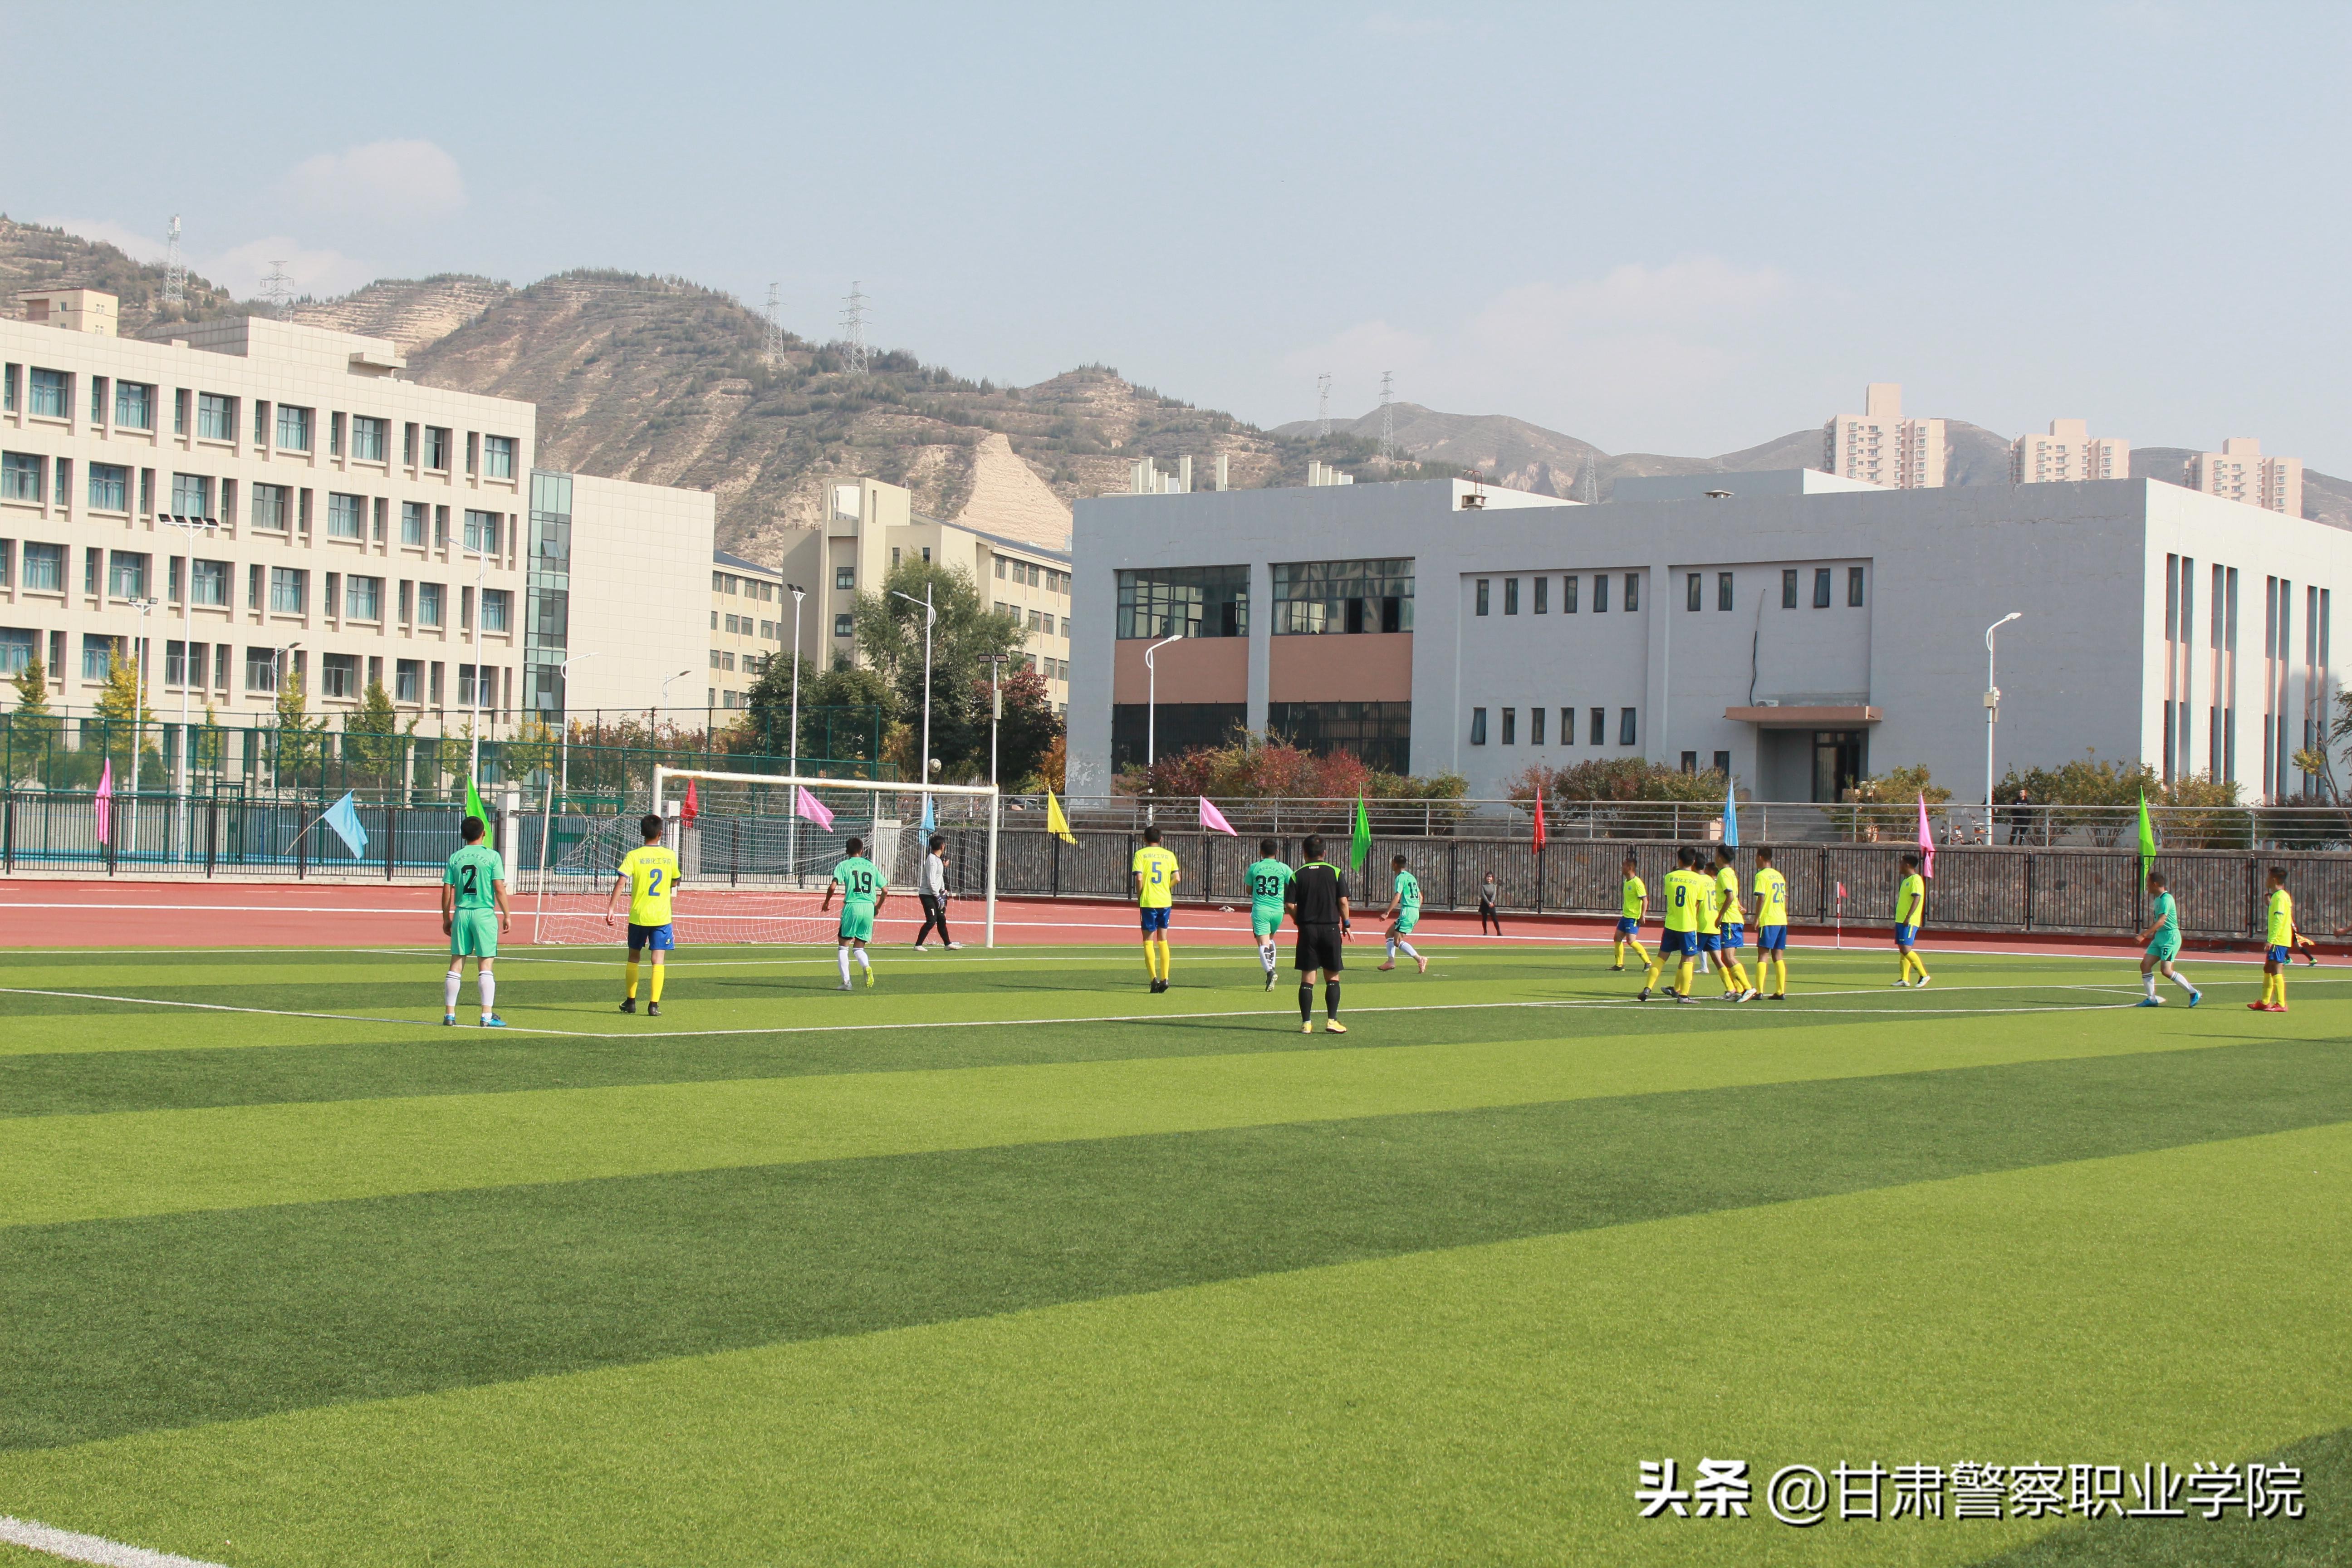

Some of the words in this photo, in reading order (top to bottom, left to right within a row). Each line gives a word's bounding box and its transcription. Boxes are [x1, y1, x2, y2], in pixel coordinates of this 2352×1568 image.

[461, 864, 477, 895] 2
[648, 868, 662, 896] 2
[852, 870, 872, 895] 19
[1152, 862, 1161, 884] 5
[1255, 875, 1279, 897] 33
[1408, 882, 1419, 899] 13
[1675, 886, 1686, 907] 8
[1772, 882, 1784, 903] 25
